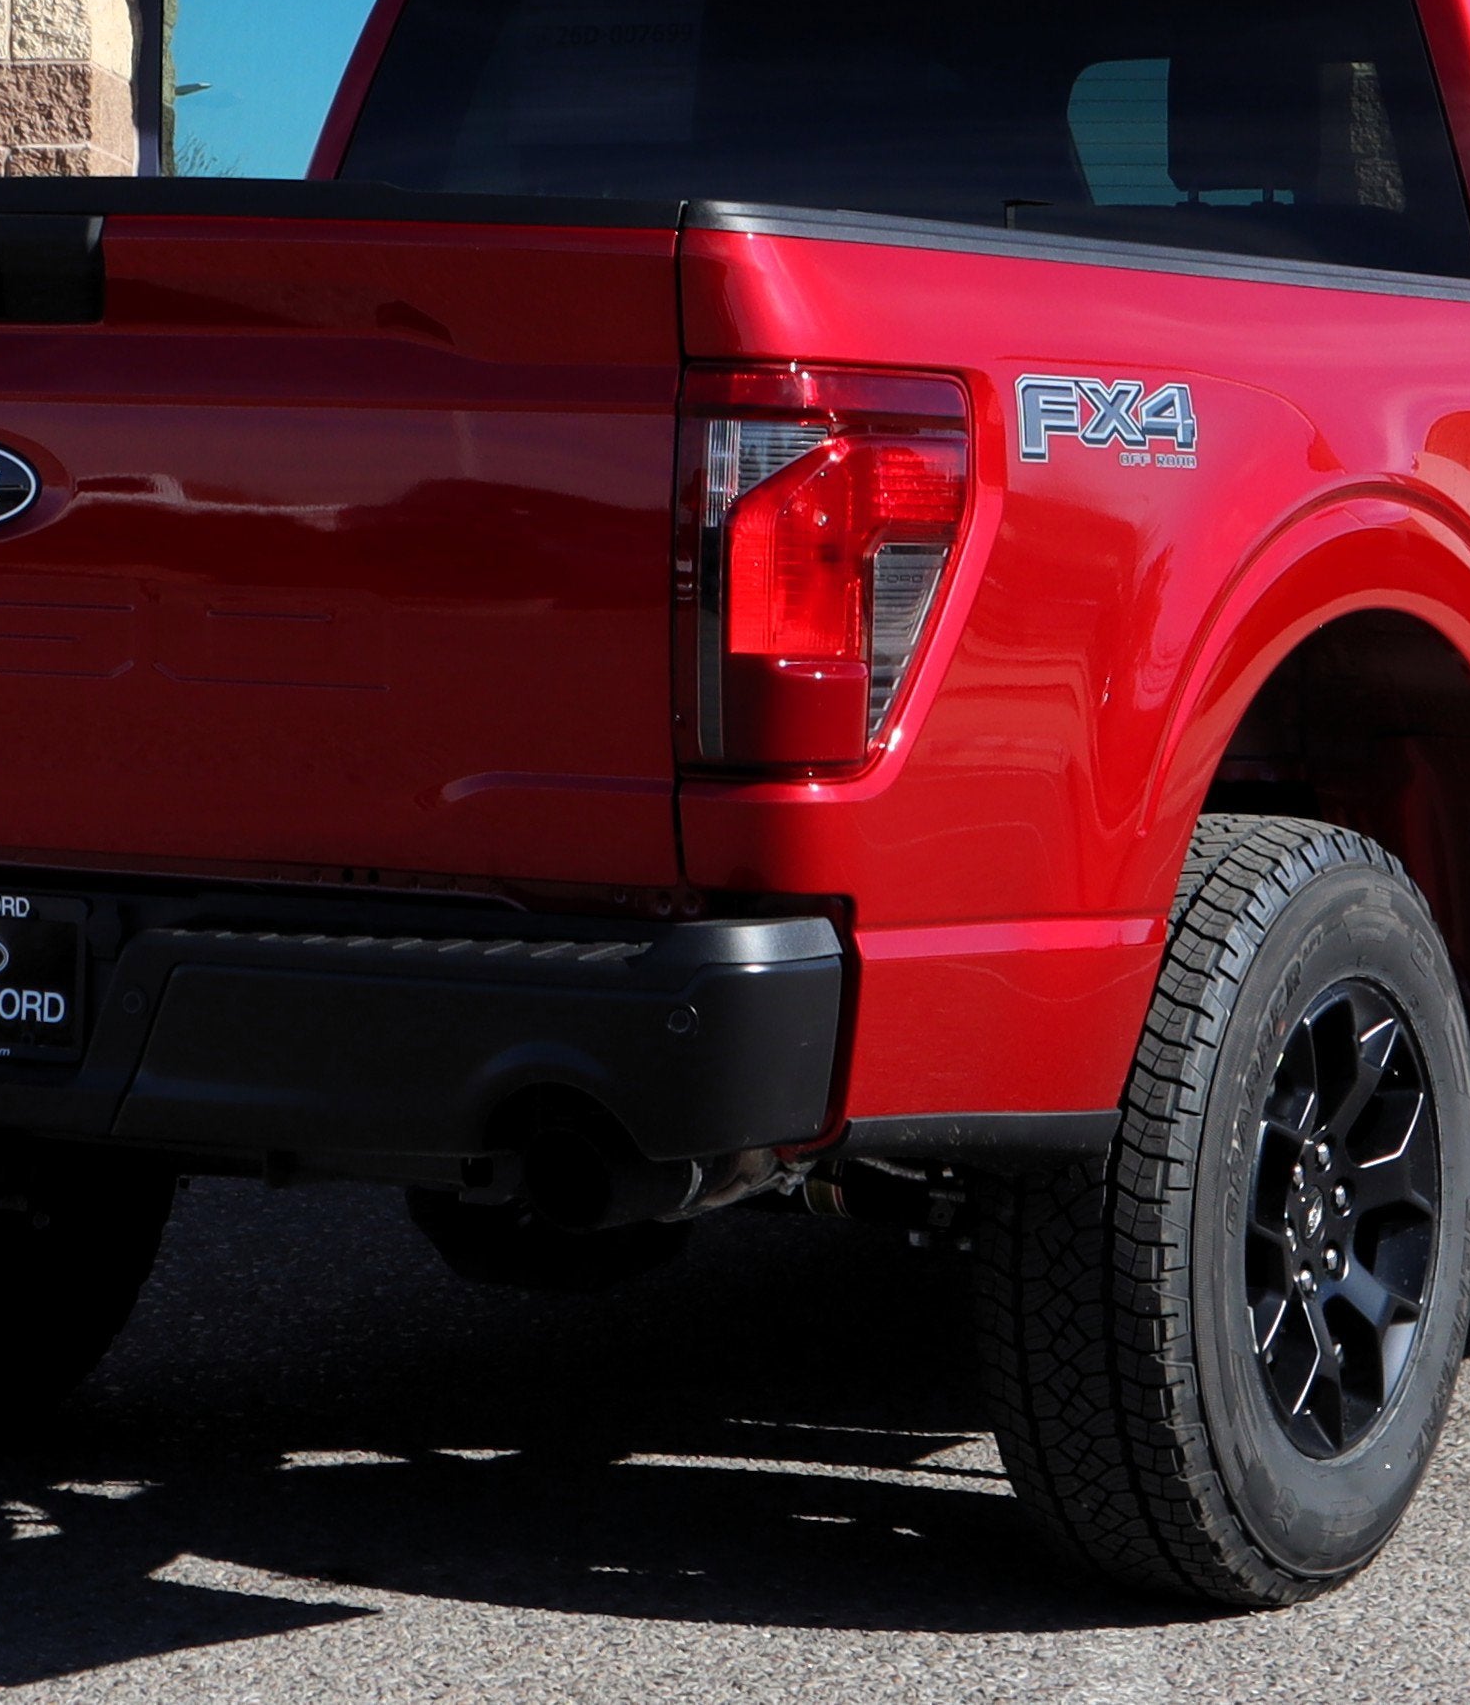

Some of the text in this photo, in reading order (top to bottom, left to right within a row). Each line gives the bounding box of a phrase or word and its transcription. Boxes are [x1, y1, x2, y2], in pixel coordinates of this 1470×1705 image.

[1015, 373, 1197, 463] FX4
[1119, 452, 1197, 469] OFF ROAD
